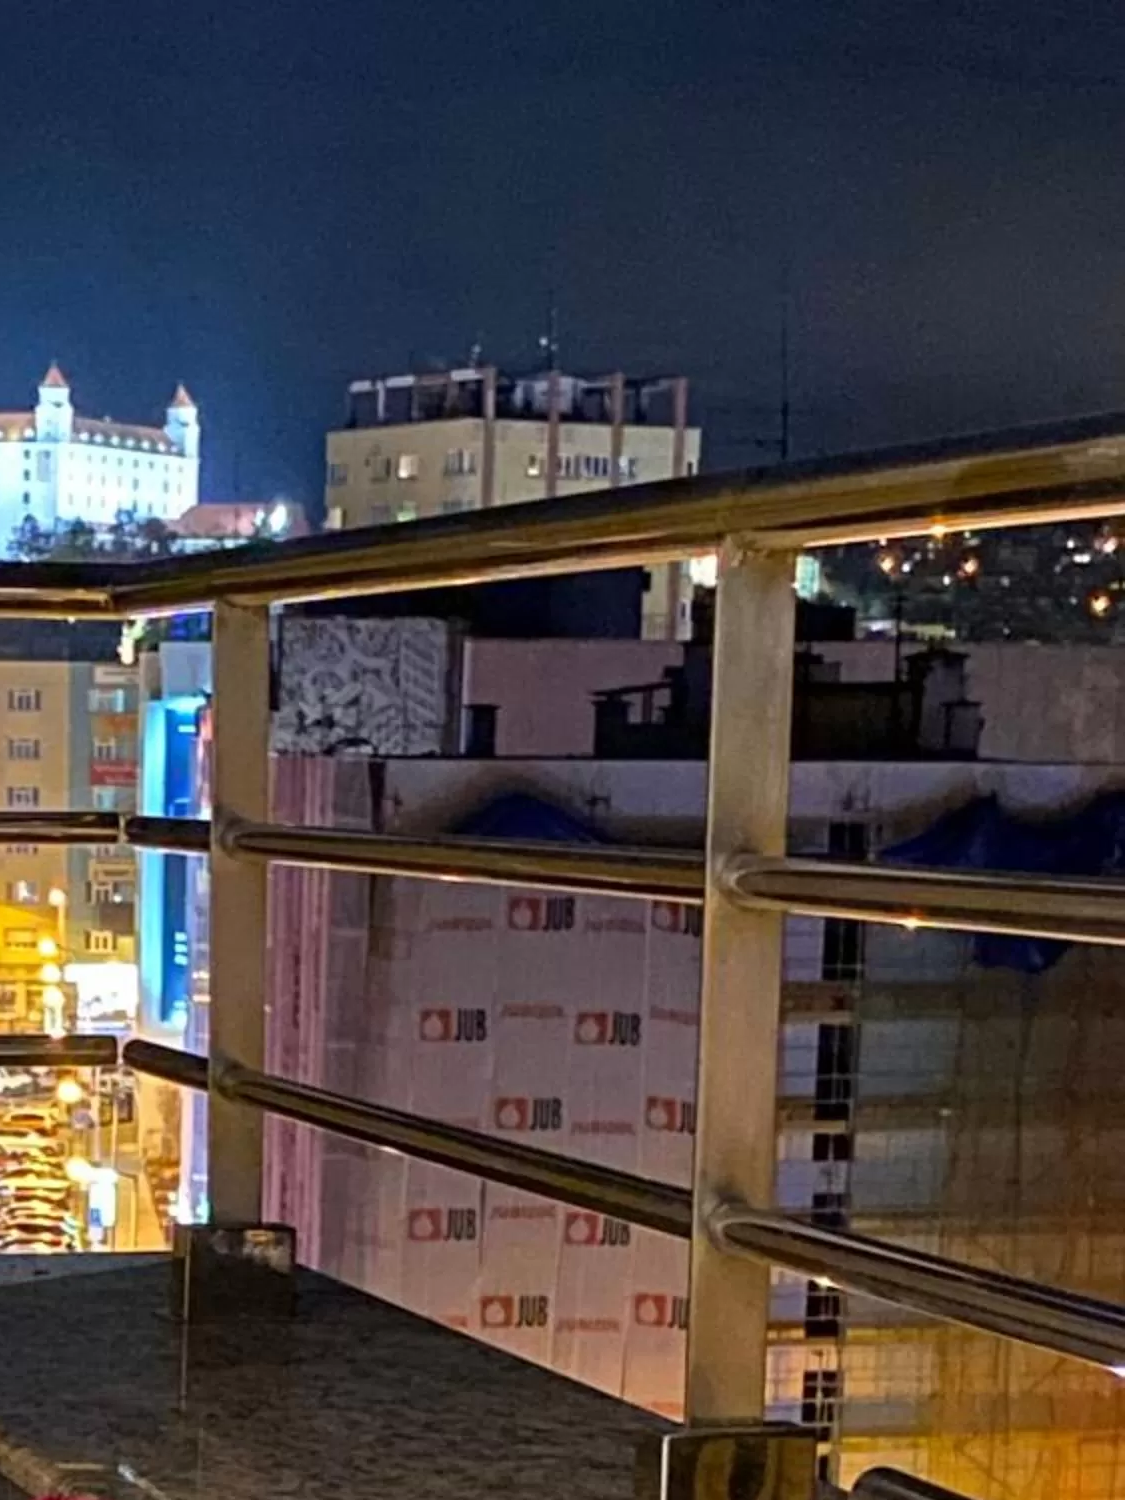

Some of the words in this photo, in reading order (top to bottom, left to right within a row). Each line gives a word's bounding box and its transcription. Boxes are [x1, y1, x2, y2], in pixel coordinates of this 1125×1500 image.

[542, 897, 575, 931] JUB
[683, 903, 703, 937] JU
[455, 1008, 487, 1041] JUB
[609, 1012, 641, 1045] JUB
[530, 1098, 563, 1130] JUB
[678, 1102, 696, 1135] JU
[443, 1209, 476, 1241] JUB
[599, 1217, 630, 1246] JUB
[515, 1296, 548, 1327] JUB
[668, 1296, 689, 1329] JU
